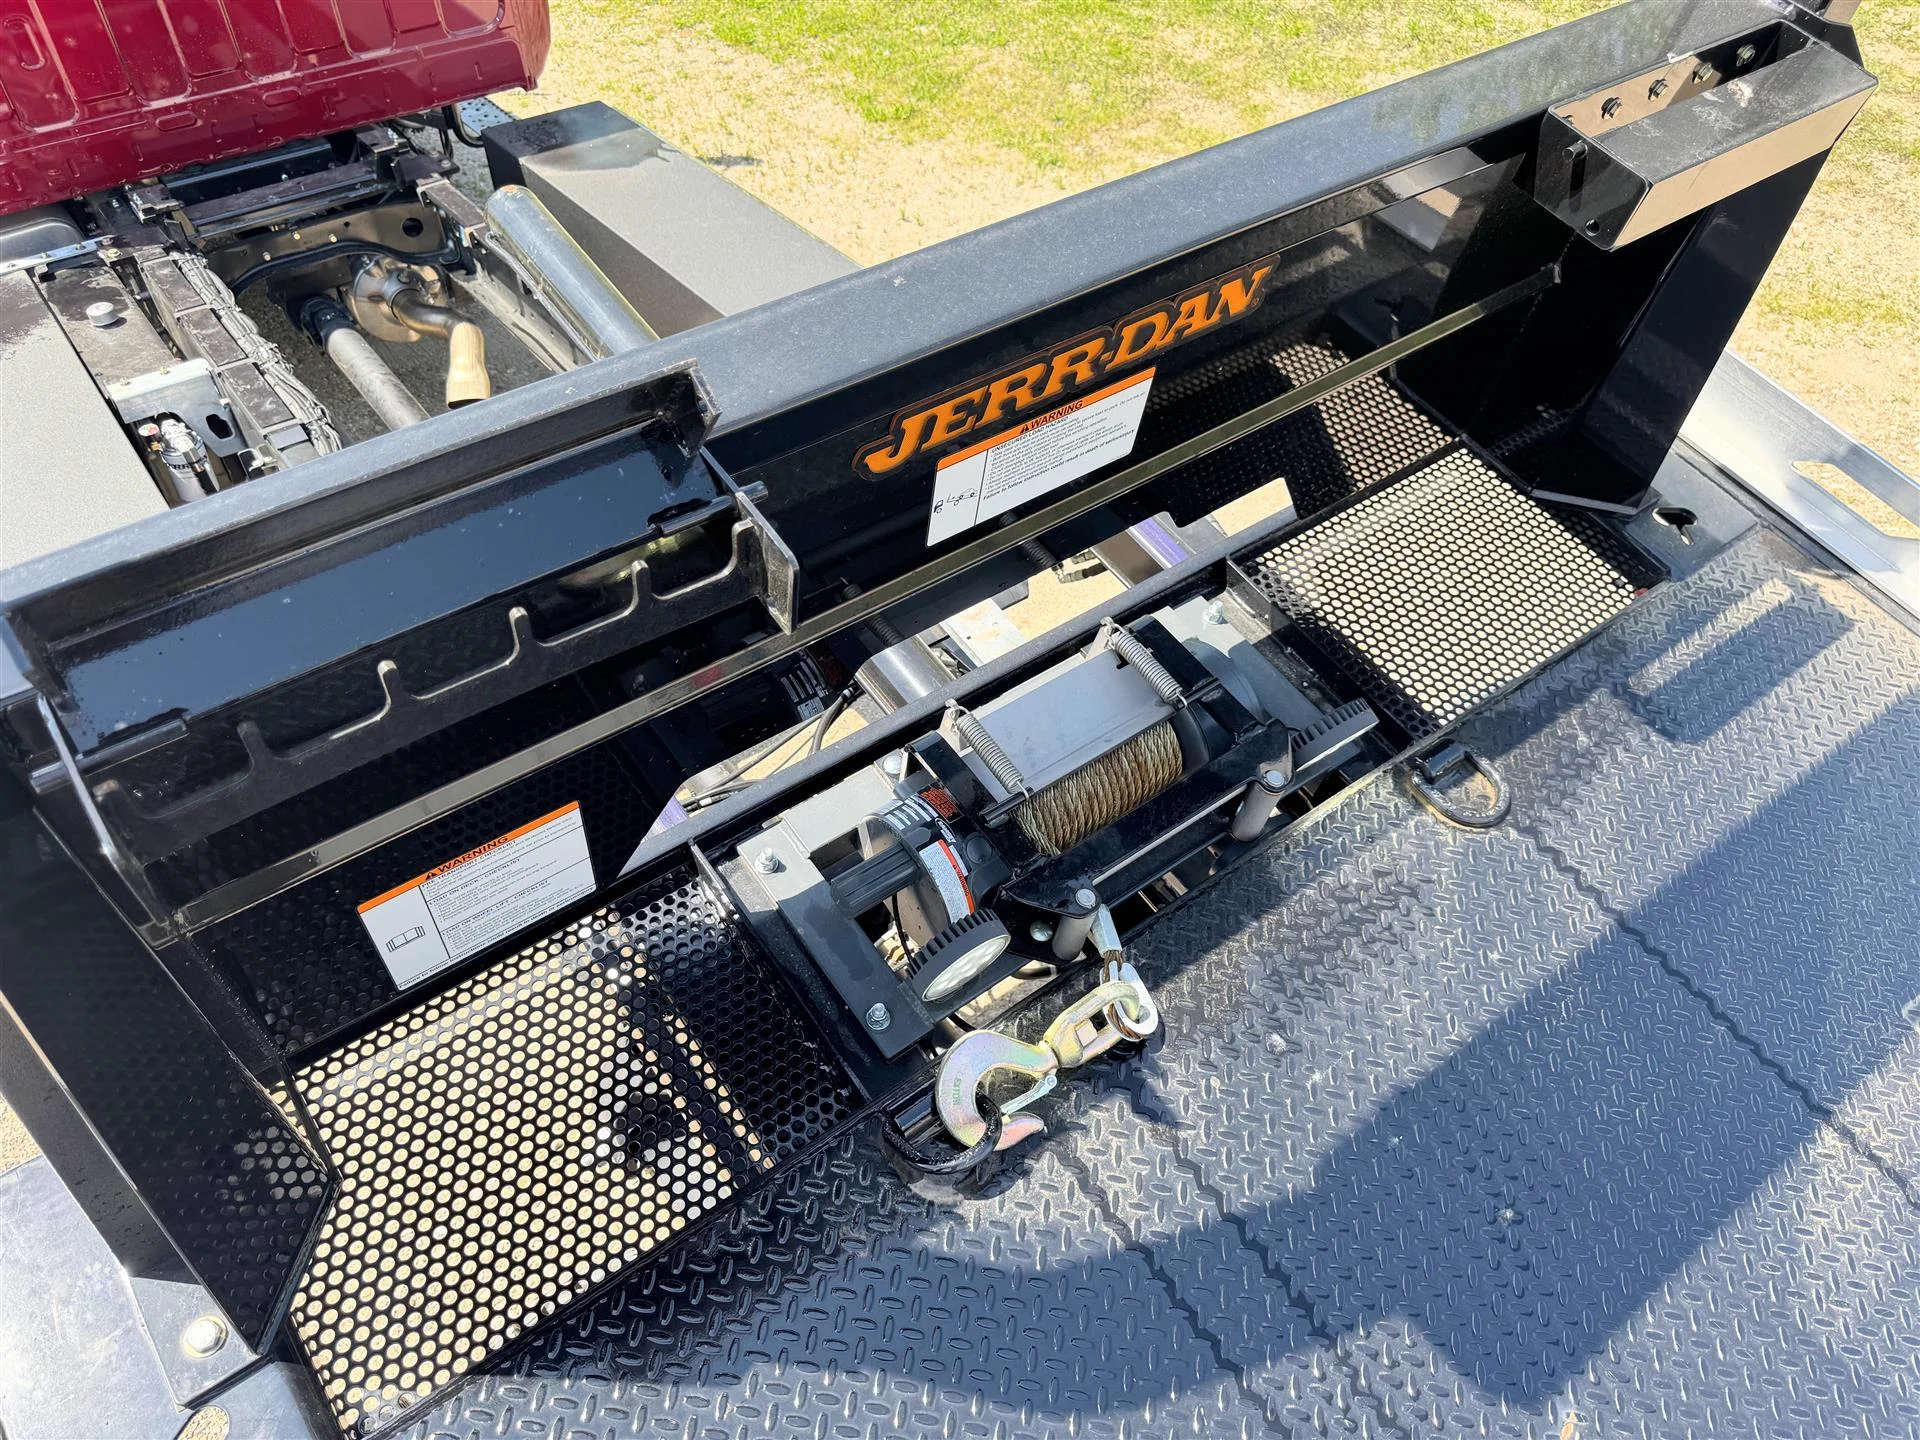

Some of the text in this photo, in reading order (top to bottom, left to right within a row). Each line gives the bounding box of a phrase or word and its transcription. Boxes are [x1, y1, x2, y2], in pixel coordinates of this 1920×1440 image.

[864, 265, 1273, 474] JERR-DAN
[1030, 398, 1084, 430] WARNING
[991, 415, 1068, 453] UNSECURED LOAD HAZARD
[437, 834, 509, 874] WARNING
[428, 893, 448, 906] LOAD
[448, 887, 459, 895] ON
[484, 857, 520, 878] CHECKLIST
[513, 879, 548, 899] CHECKLIST
